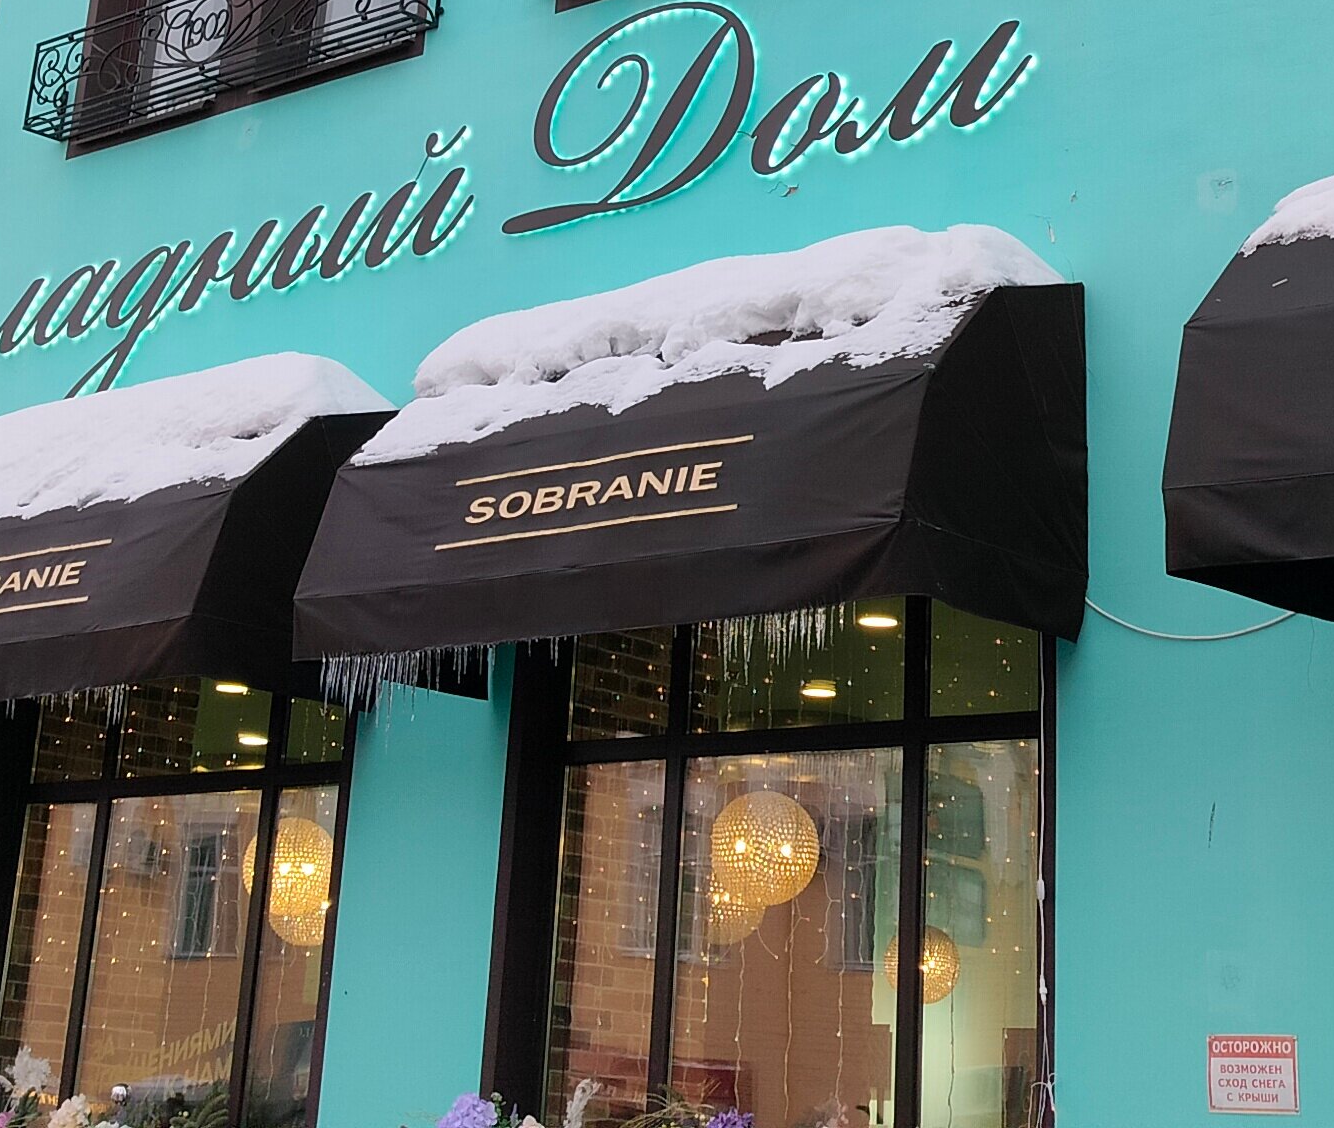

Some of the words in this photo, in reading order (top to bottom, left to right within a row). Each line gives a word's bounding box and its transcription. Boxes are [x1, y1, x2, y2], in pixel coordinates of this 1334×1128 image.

[501, 1, 1024, 236] Дом
[464, 461, 723, 524] SOBRANIE
[1212, 1040, 1292, 1054] ОСТОРОЖНО
[1220, 1064, 1282, 1075] ВОЗМОЖЕН
[1218, 1078, 1248, 1090] СХОД
[1251, 1078, 1286, 1089] СНЕГА
[1226, 1092, 1234, 1102] С
[1238, 1092, 1279, 1103] КРЫШИ
